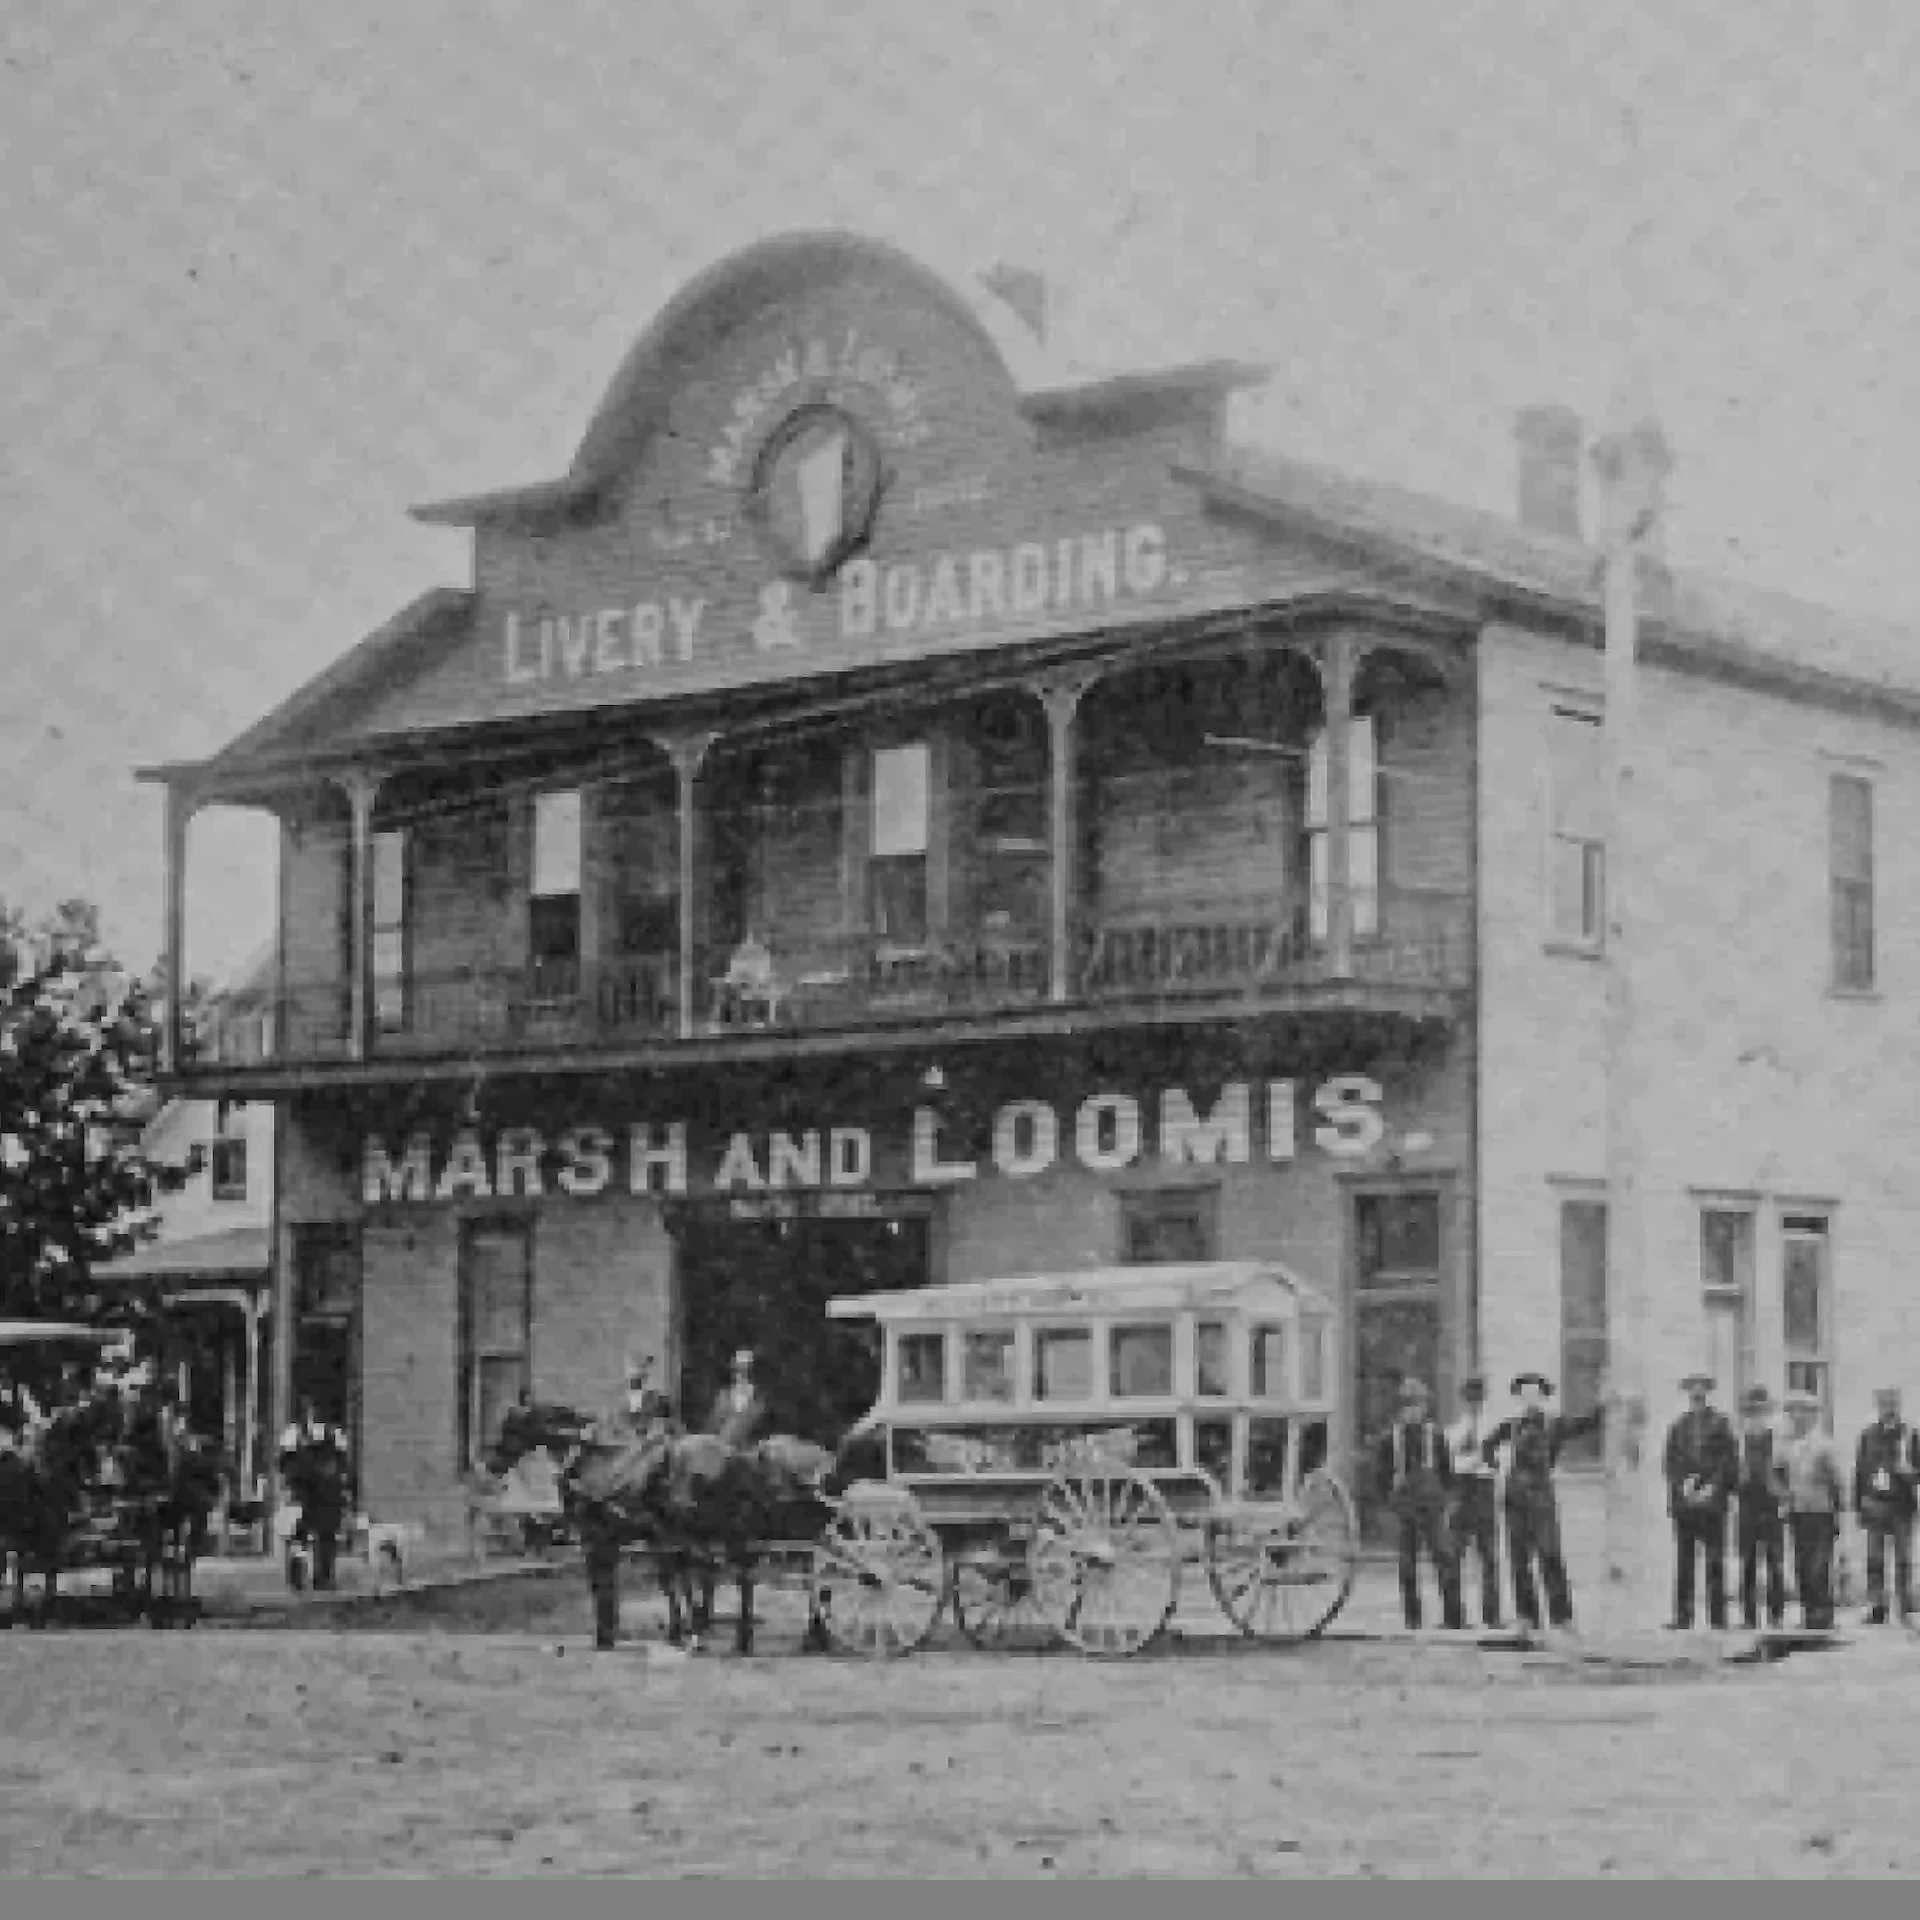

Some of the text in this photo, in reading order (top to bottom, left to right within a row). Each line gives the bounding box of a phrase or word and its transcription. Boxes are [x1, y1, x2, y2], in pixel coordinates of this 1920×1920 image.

[505, 599, 706, 683] LIVERY
[753, 580, 792, 651] &
[362, 1122, 688, 1201] MARSH
[713, 1126, 872, 1190] AND
